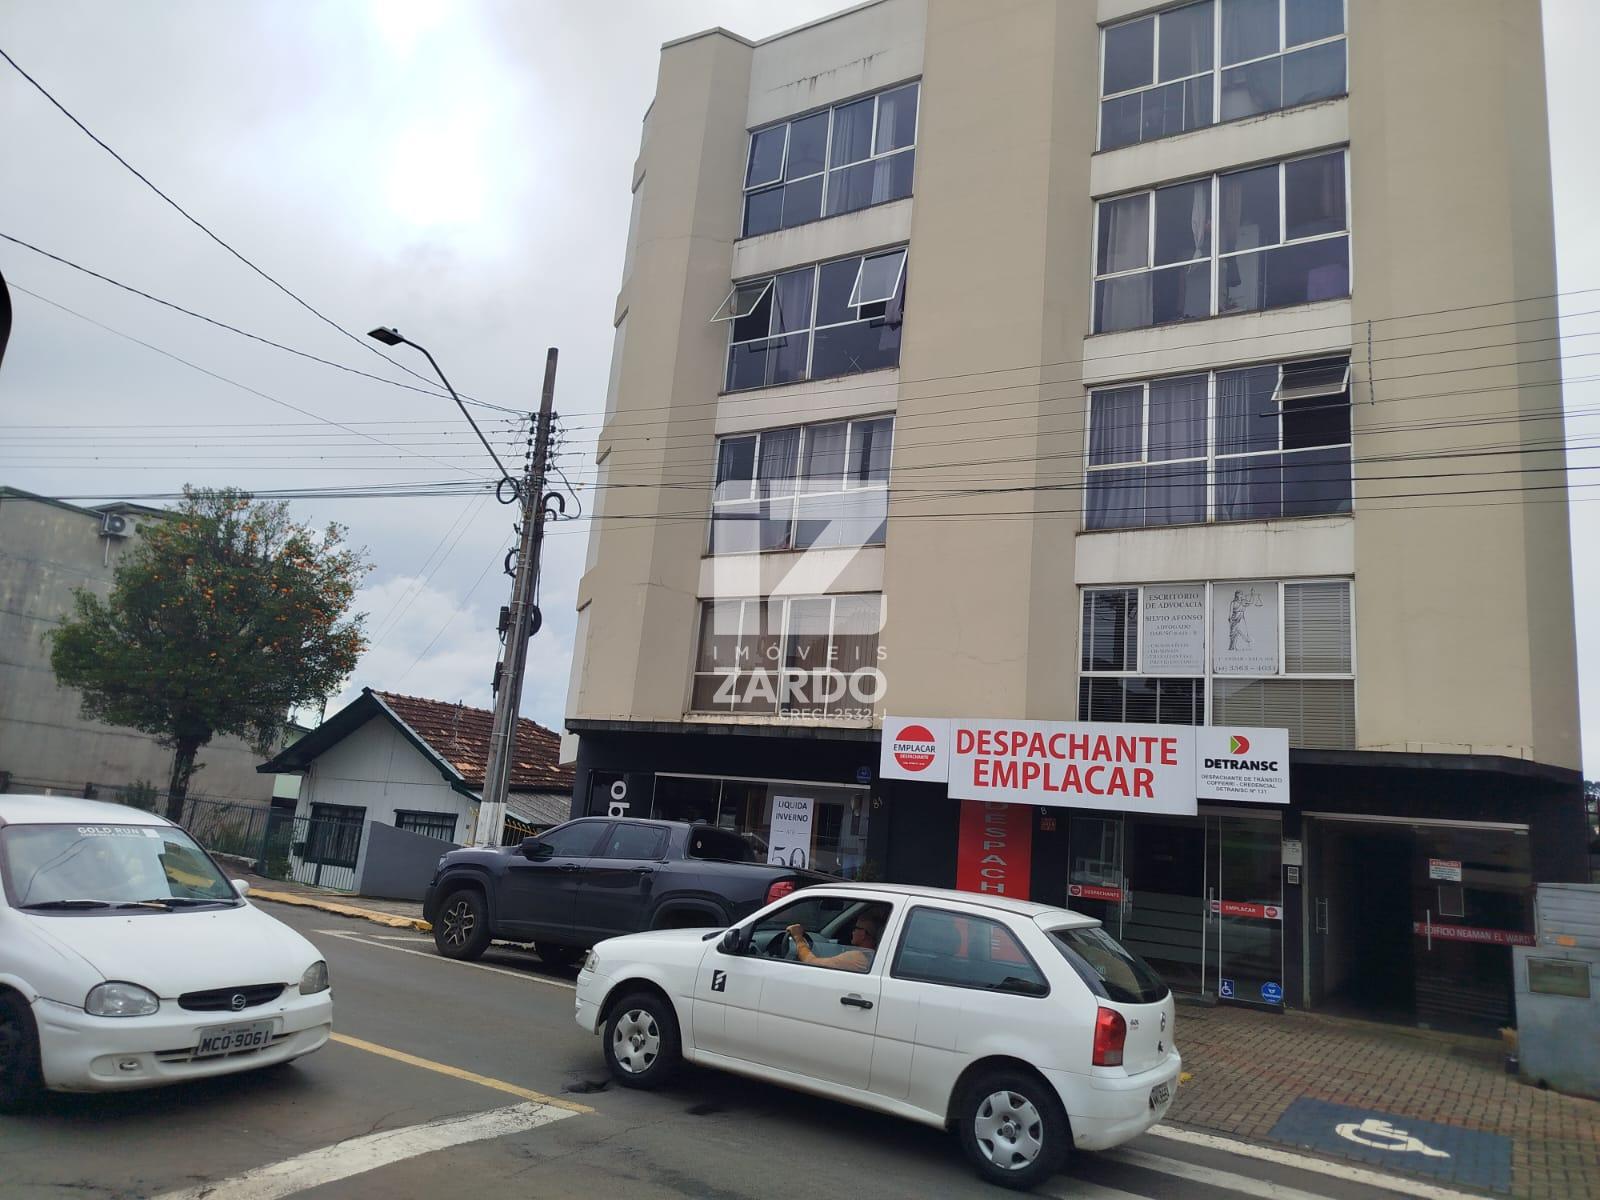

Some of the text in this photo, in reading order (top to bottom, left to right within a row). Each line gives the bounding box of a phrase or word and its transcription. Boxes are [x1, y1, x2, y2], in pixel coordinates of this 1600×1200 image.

[1159, 601, 1203, 609] ADVOCACIA
[893, 743, 936, 753] EMPLACAR
[955, 729, 1178, 766] DESPACHANTE
[1204, 758, 1278, 772] DETRANSC
[972, 758, 1155, 798] EMPLACAR
[1201, 774, 1242, 782] DESPACHANTE
[1240, 781, 1277, 789] CREDENCIAL
[778, 800, 808, 810] LIQUIDA
[775, 812, 808, 822] INVERNO
[1225, 905, 1256, 913] EMPLACAR
